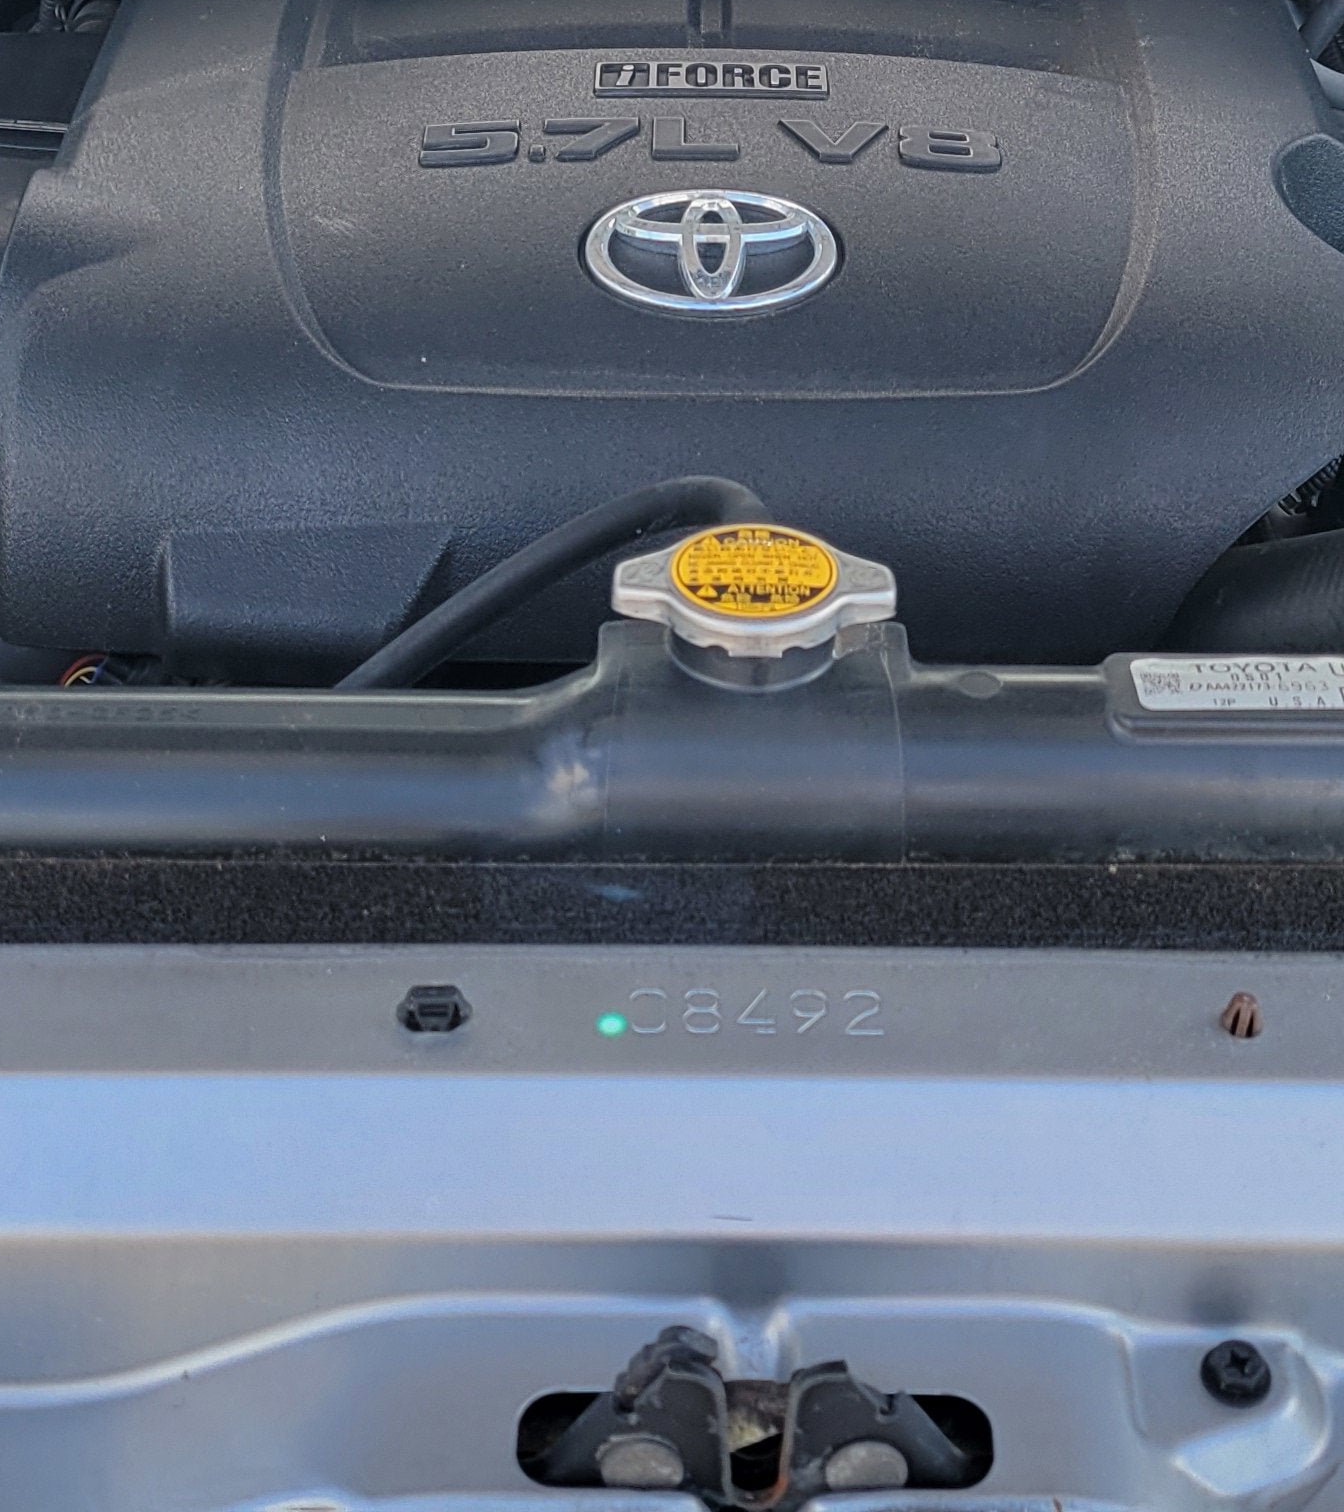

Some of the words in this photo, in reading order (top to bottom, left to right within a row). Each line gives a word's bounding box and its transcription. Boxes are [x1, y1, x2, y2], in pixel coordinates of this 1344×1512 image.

[418, 116, 741, 169] 5.7L
[777, 118, 1004, 172] V8
[727, 583, 811, 597] ATTENTION
[1195, 661, 1317, 674] TOYOTA
